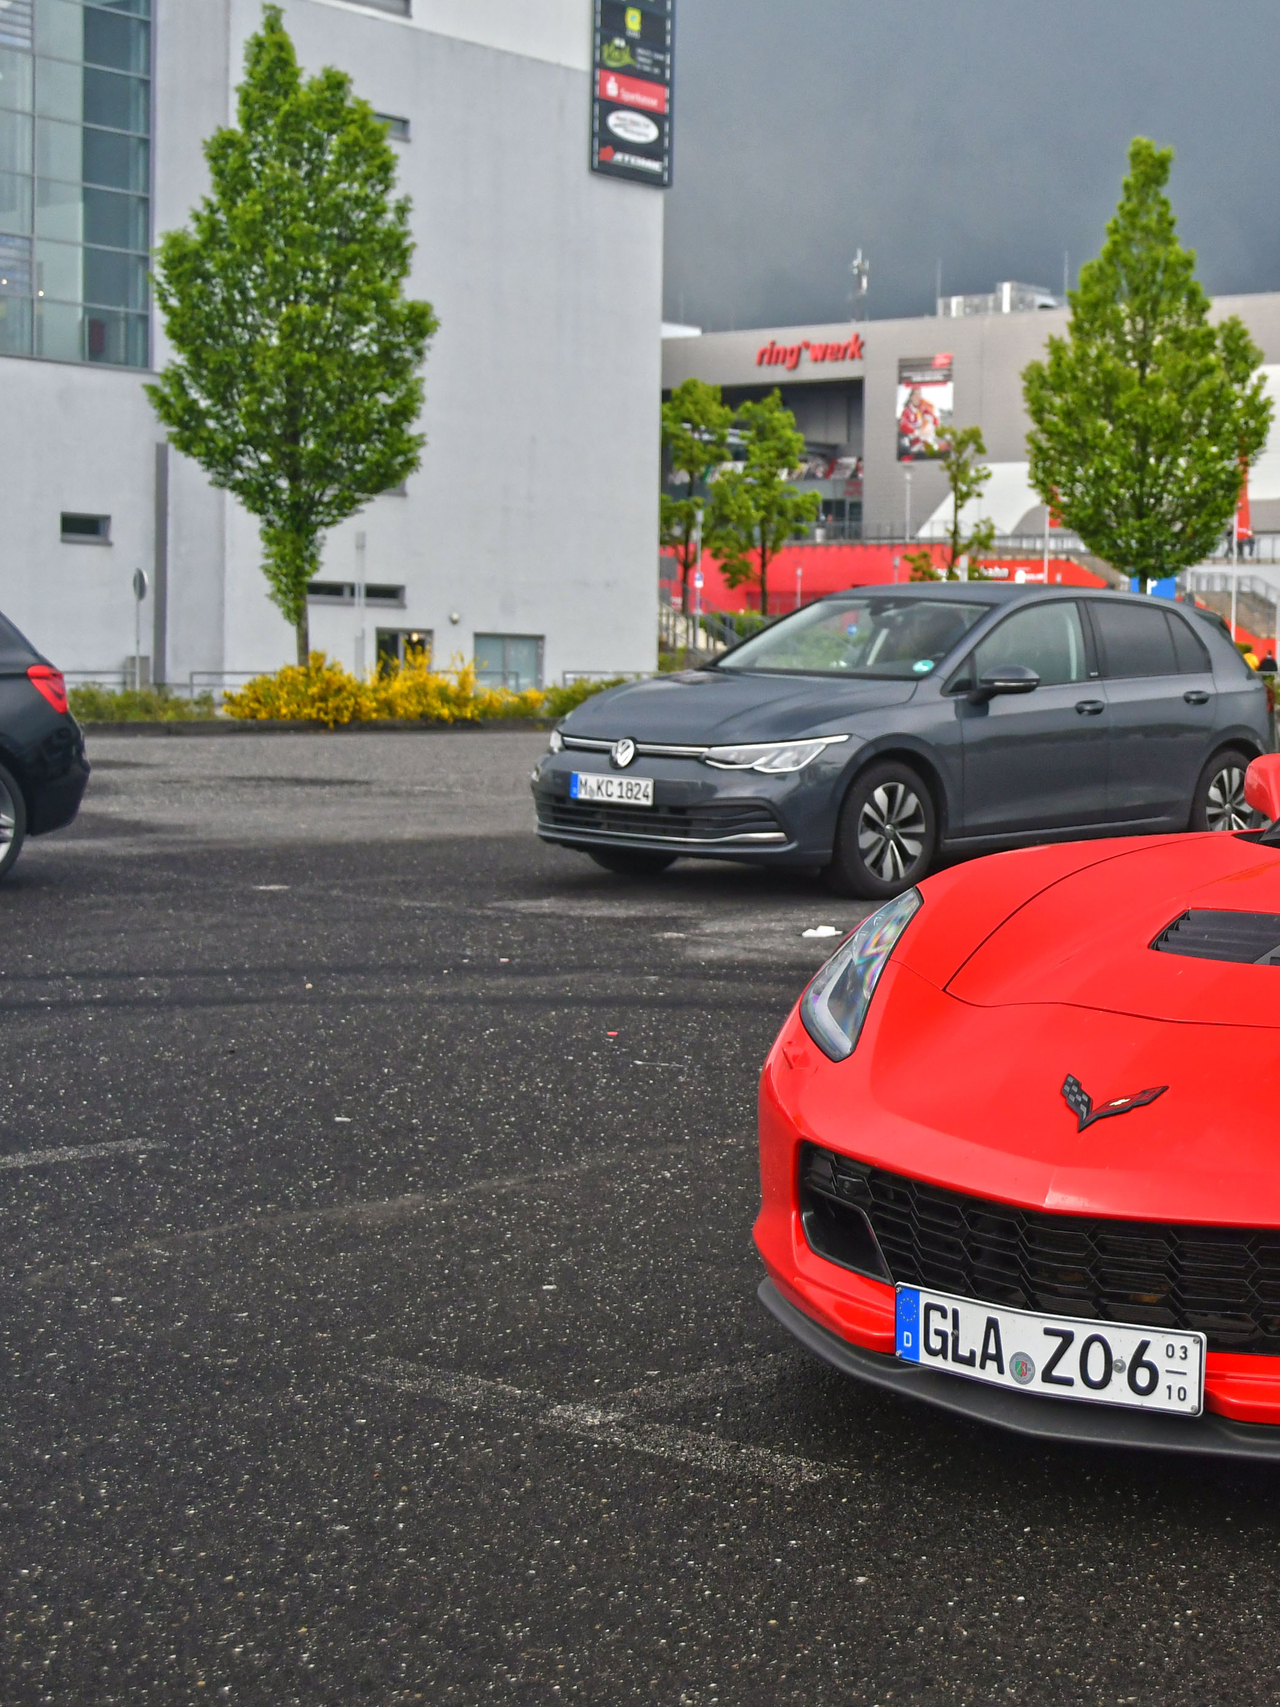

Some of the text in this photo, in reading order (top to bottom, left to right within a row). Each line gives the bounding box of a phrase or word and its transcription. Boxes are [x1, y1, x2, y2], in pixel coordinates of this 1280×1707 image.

[579, 778, 588, 796] M
[903, 1330, 912, 1347] D
[922, 1300, 1005, 1375] GLA
[1165, 1342, 1188, 1360] 03
[1165, 1384, 1187, 1401] 10
